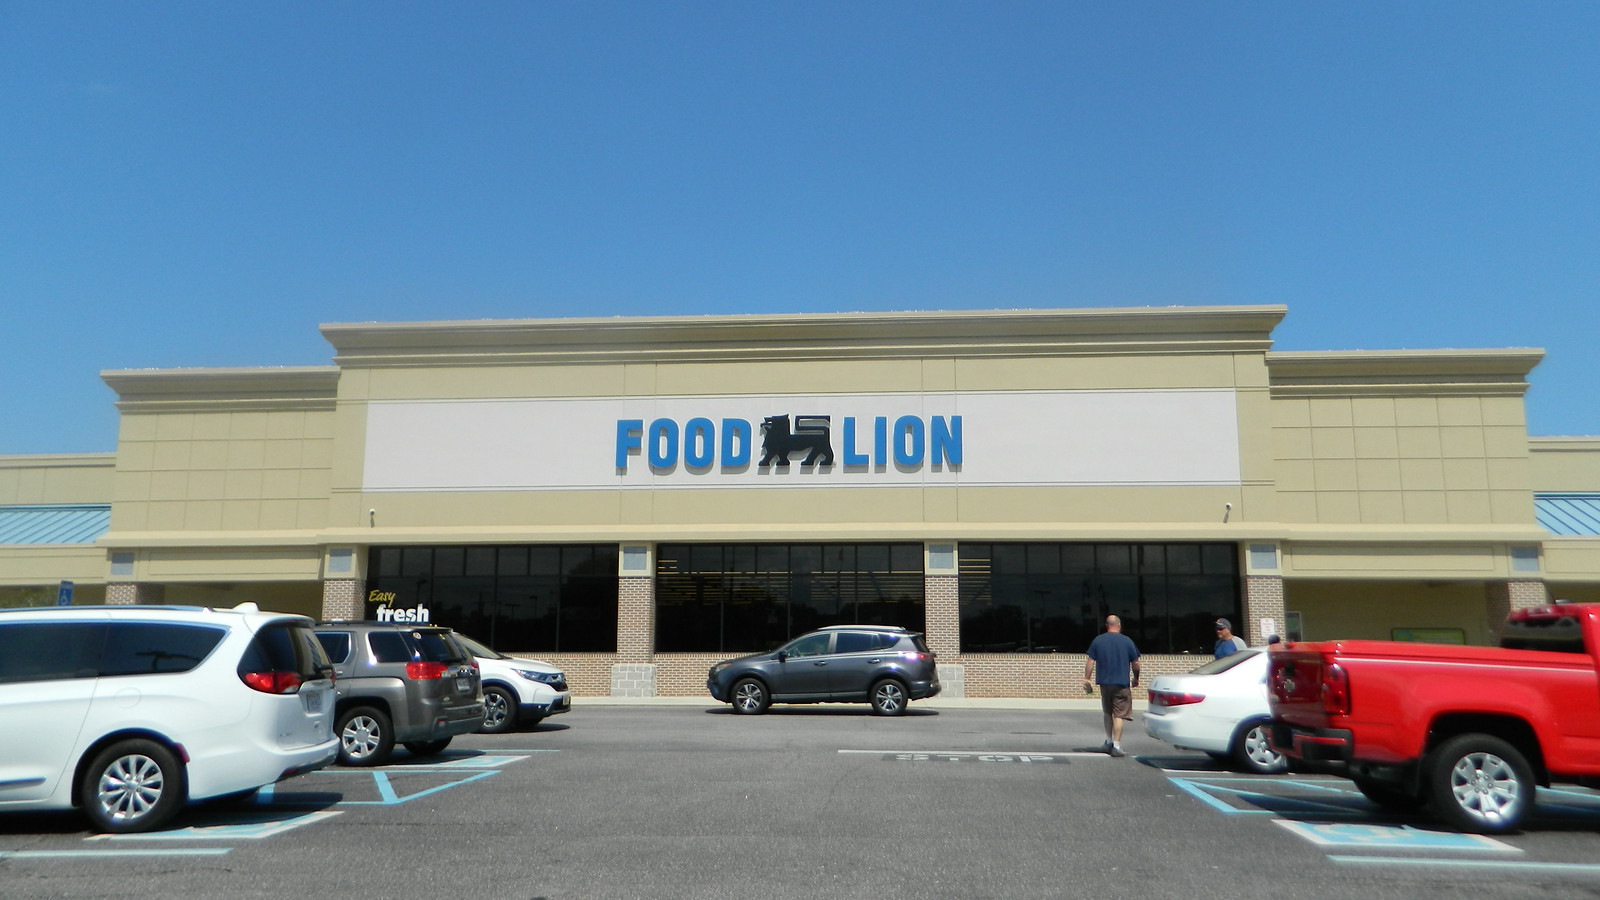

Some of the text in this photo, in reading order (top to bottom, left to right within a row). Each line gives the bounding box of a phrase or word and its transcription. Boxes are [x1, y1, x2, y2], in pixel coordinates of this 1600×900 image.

[615, 415, 963, 469] FOOD LION
[369, 589, 395, 608] Easy
[376, 603, 429, 622] fresh
[896, 754, 1053, 762] STOP
